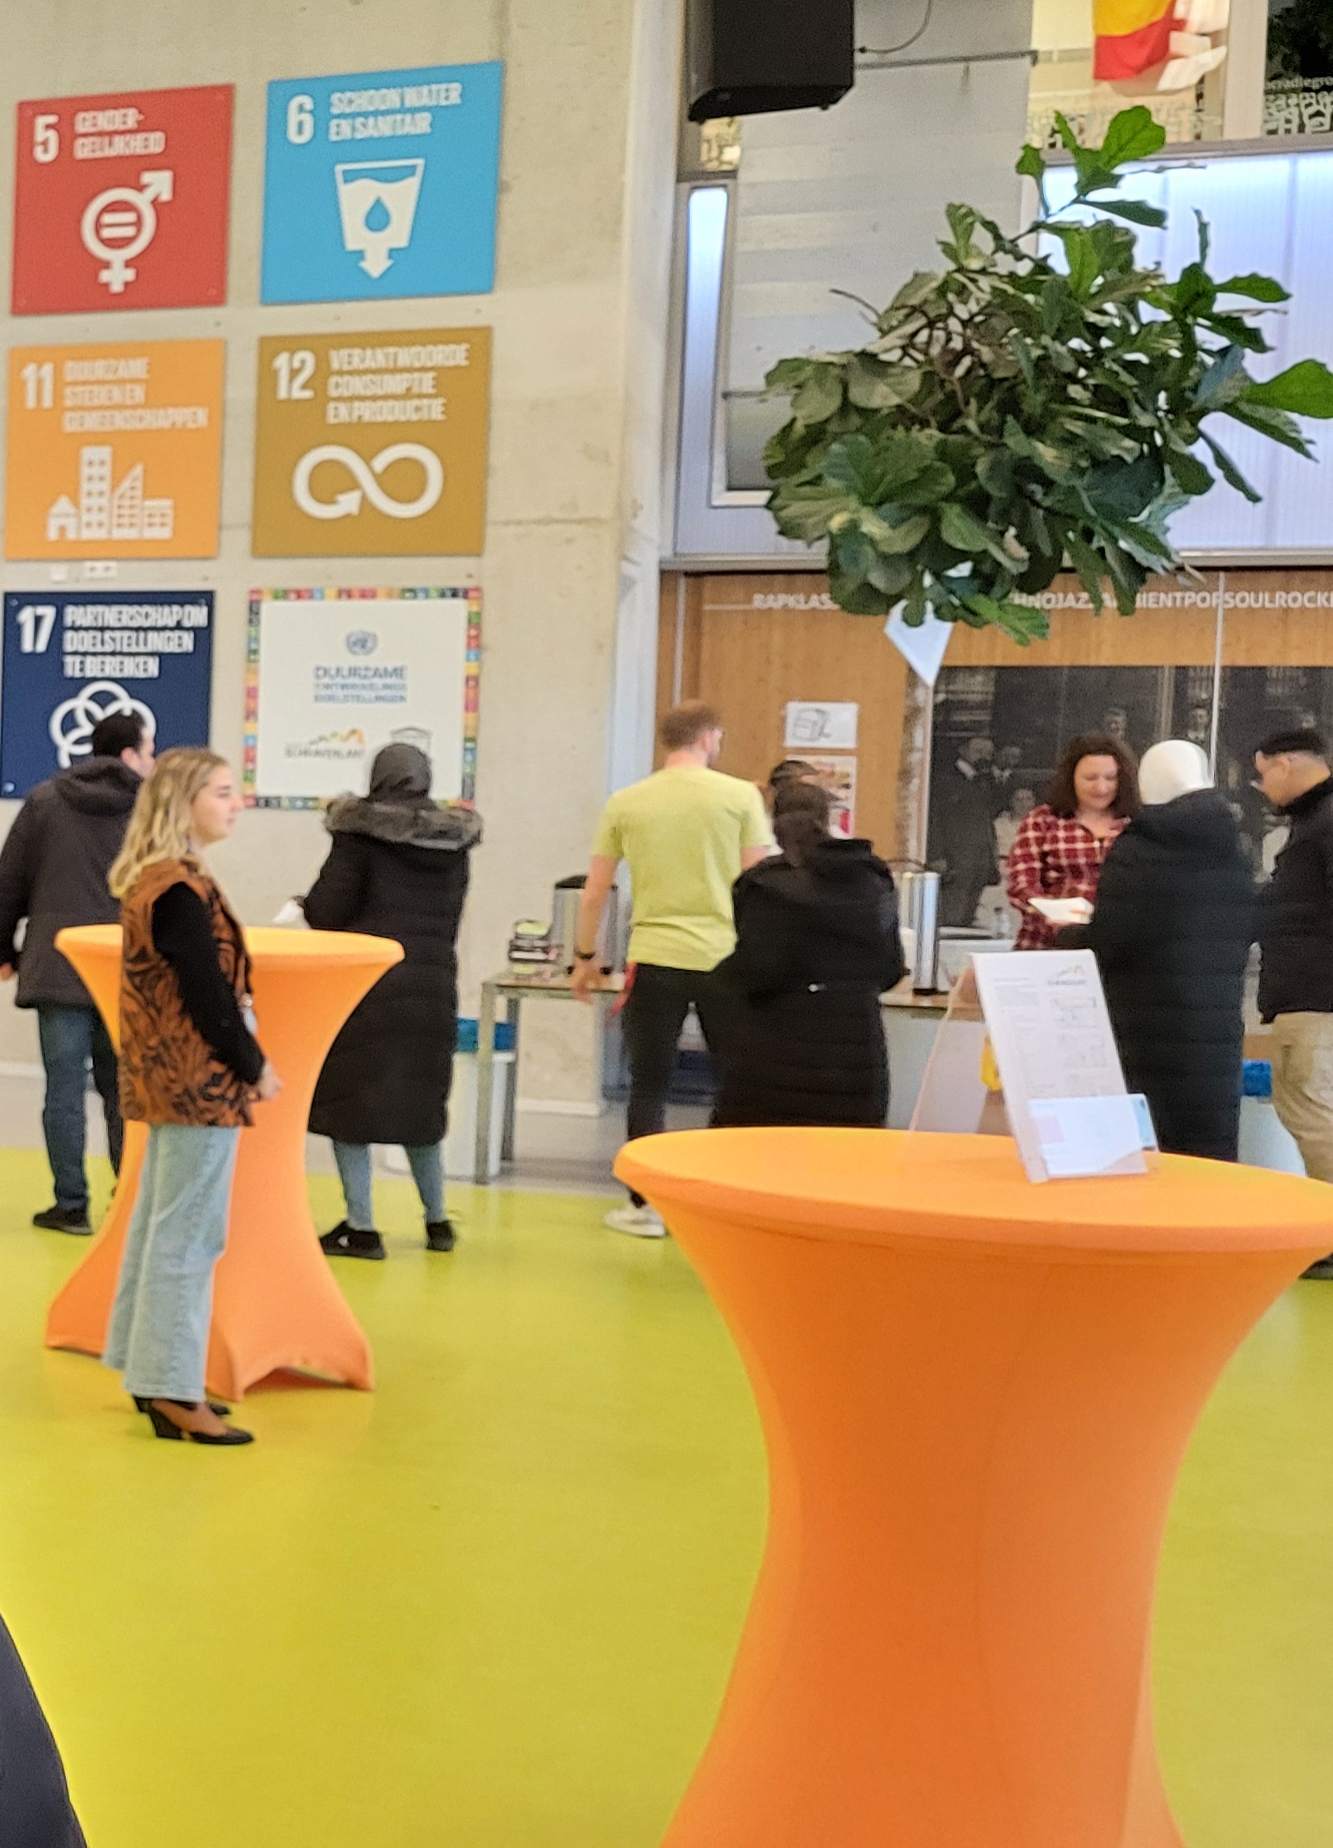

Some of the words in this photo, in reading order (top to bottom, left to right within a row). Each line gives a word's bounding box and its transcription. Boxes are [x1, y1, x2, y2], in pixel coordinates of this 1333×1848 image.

[330, 87, 400, 114] SCHOON
[403, 82, 462, 108] WATER
[74, 107, 145, 134] GENDER-
[287, 94, 314, 144] 6
[329, 118, 351, 141] EN
[354, 112, 432, 139] SANITAIR
[34, 114, 59, 163] 5
[73, 131, 166, 160] GELIJKHEID
[64, 357, 149, 382] DUURZAME
[329, 343, 470, 371] VERANTWOORDE
[21, 362, 54, 409] 11
[273, 350, 316, 400] 12
[327, 371, 437, 398] CONSUMPTIE
[64, 384, 124, 407] STEDEN
[126, 382, 146, 405] EN
[63, 401, 209, 433] GEMEENSCHAPPEN
[326, 400, 352, 424] EN
[353, 397, 447, 422] PRODUCTIE
[17, 605, 56, 654] 17
[64, 604, 180, 628] PARTNERSCHAP
[182, 604, 208, 628] OM
[63, 629, 194, 653] DOELSTELLINGEN
[64, 655, 84, 678] TE
[85, 655, 160, 678] BEREIKEN
[314, 665, 406, 680] DUURZAME
